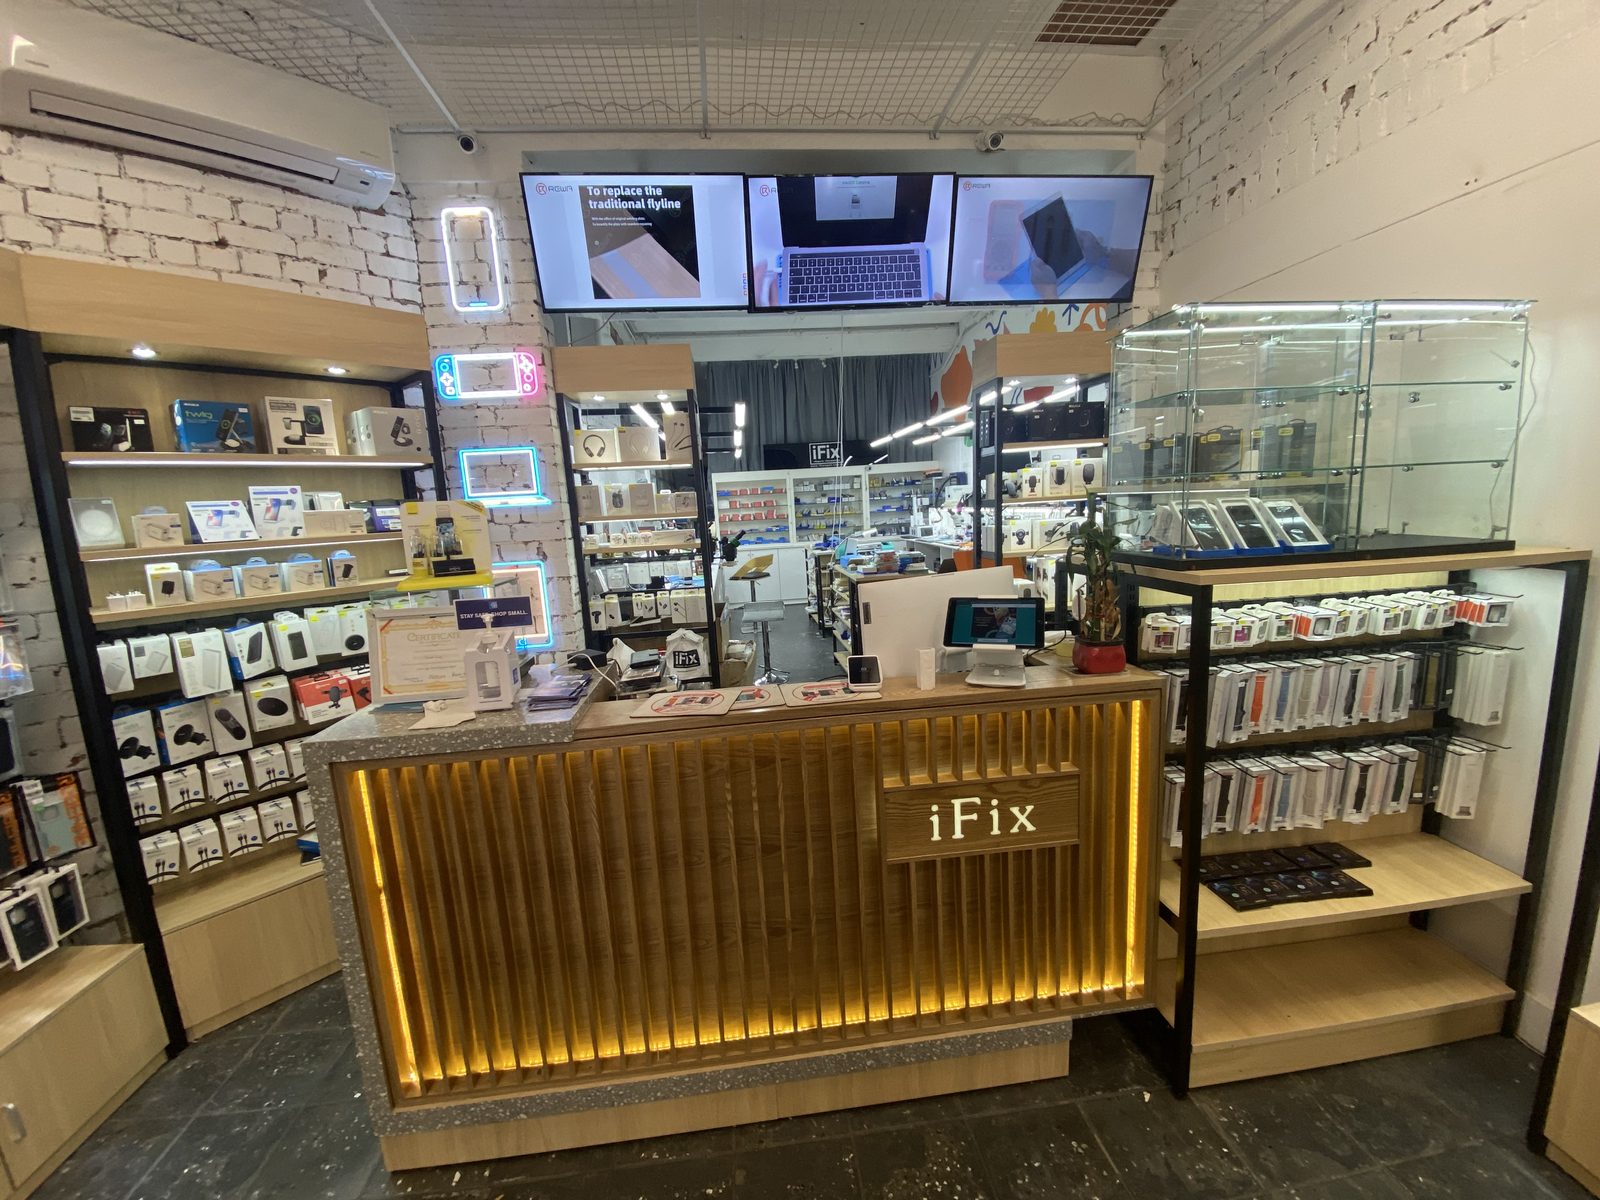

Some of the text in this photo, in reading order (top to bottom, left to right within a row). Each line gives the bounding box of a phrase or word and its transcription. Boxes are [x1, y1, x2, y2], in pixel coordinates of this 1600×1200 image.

[587, 185, 663, 198] To replace the
[589, 198, 681, 211] traditional flyline
[812, 445, 840, 459] iFix
[675, 652, 698, 664] iFix
[929, 796, 1037, 842] iFix
